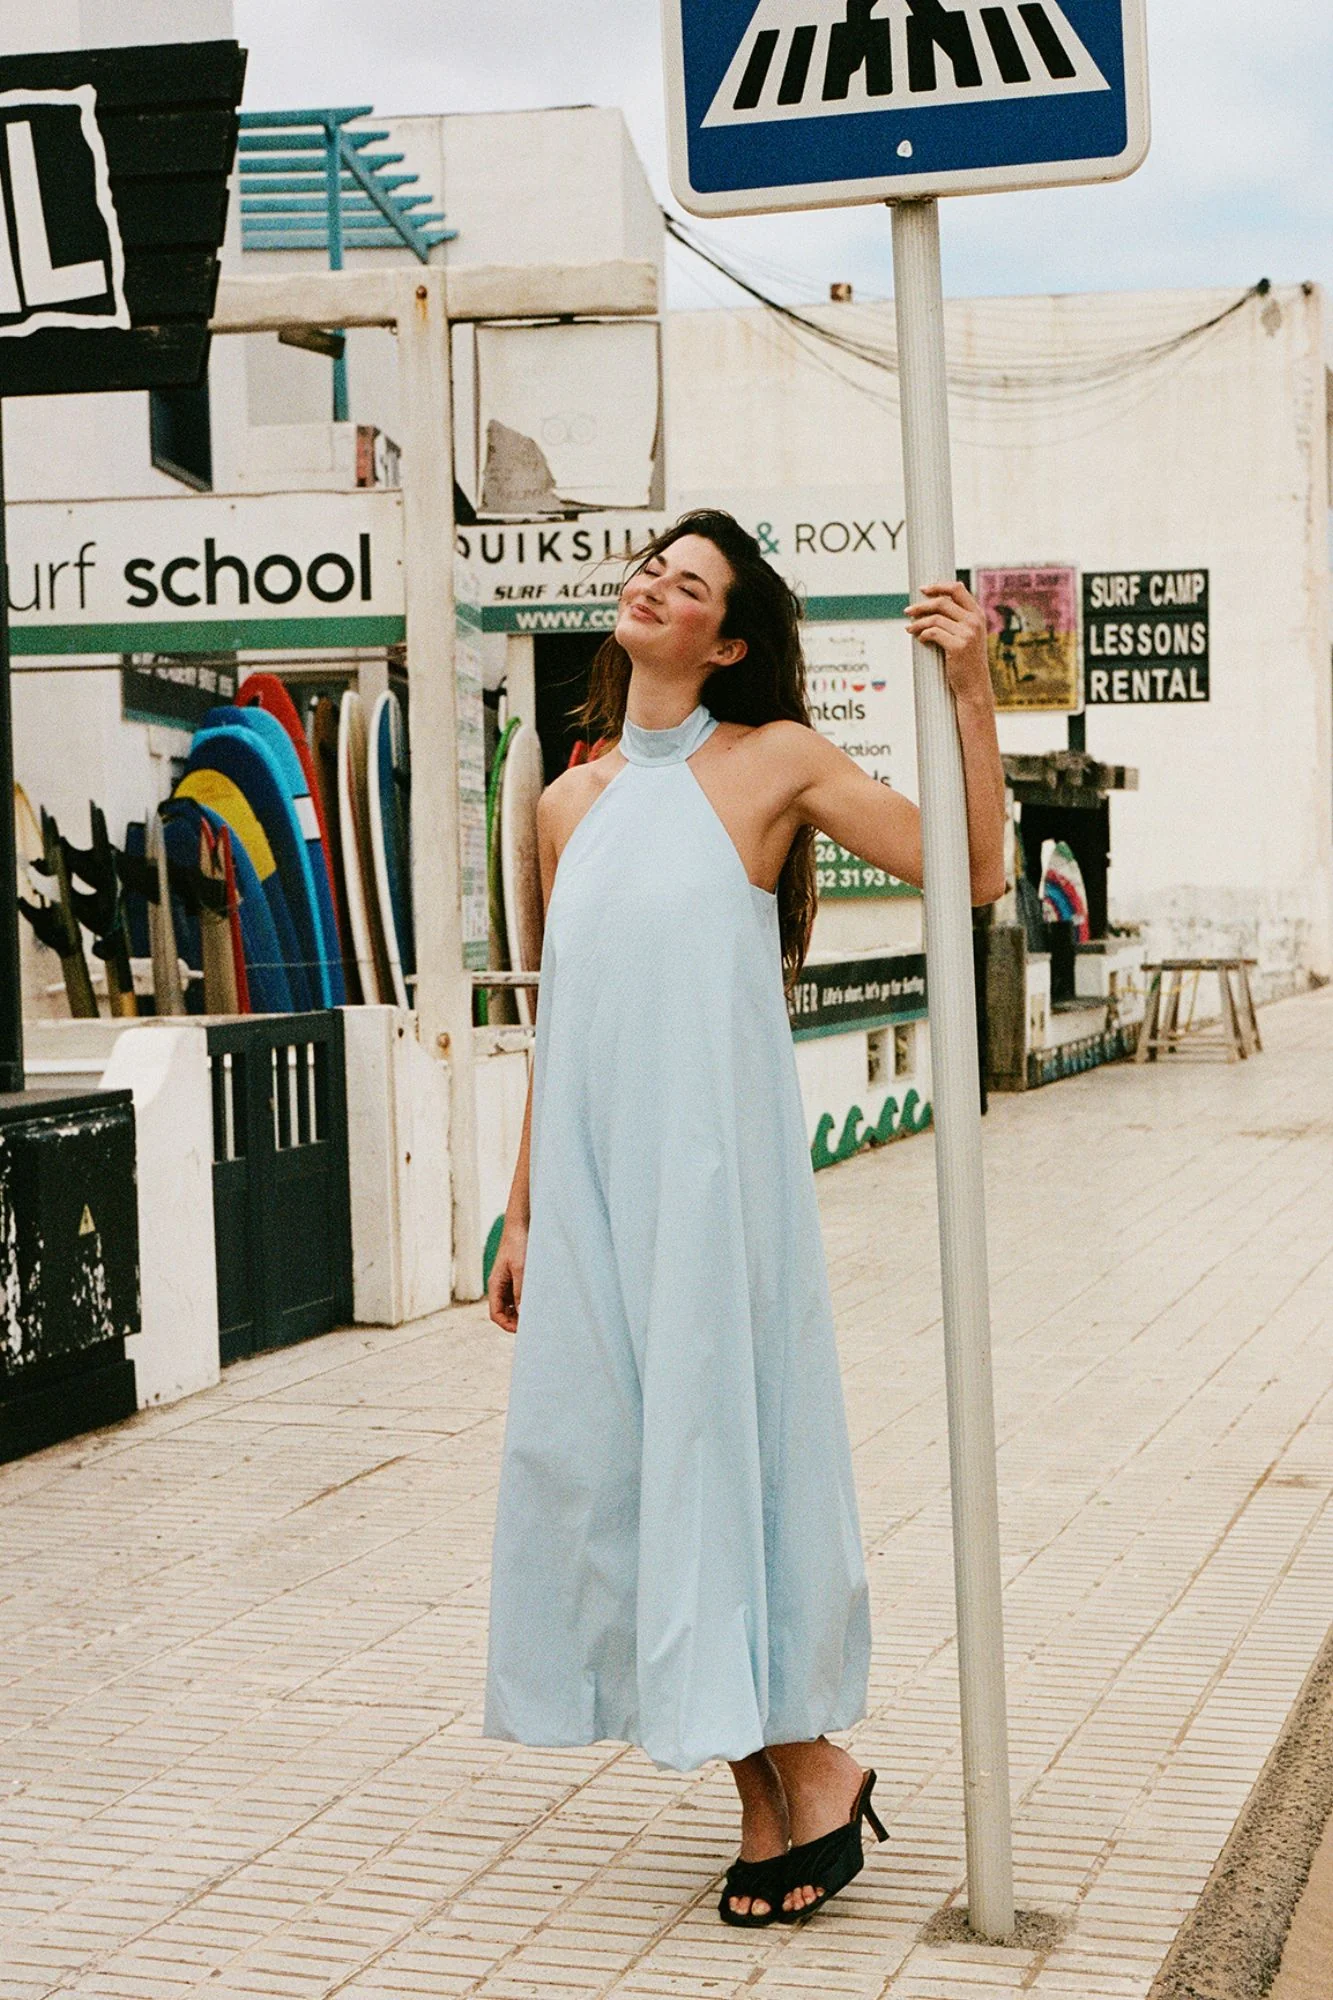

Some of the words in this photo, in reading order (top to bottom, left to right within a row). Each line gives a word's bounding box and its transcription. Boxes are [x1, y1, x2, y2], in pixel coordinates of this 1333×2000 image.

[0, 120, 108, 314] L
[757, 522, 779, 555] &
[795, 519, 905, 554] ROXY
[124, 533, 372, 607] school
[494, 585, 548, 600] SURF
[1090, 575, 1141, 608] SURF
[1149, 572, 1205, 606] CAMP
[1089, 621, 1206, 656] LESSONS
[1090, 667, 1206, 701] RENTAL
